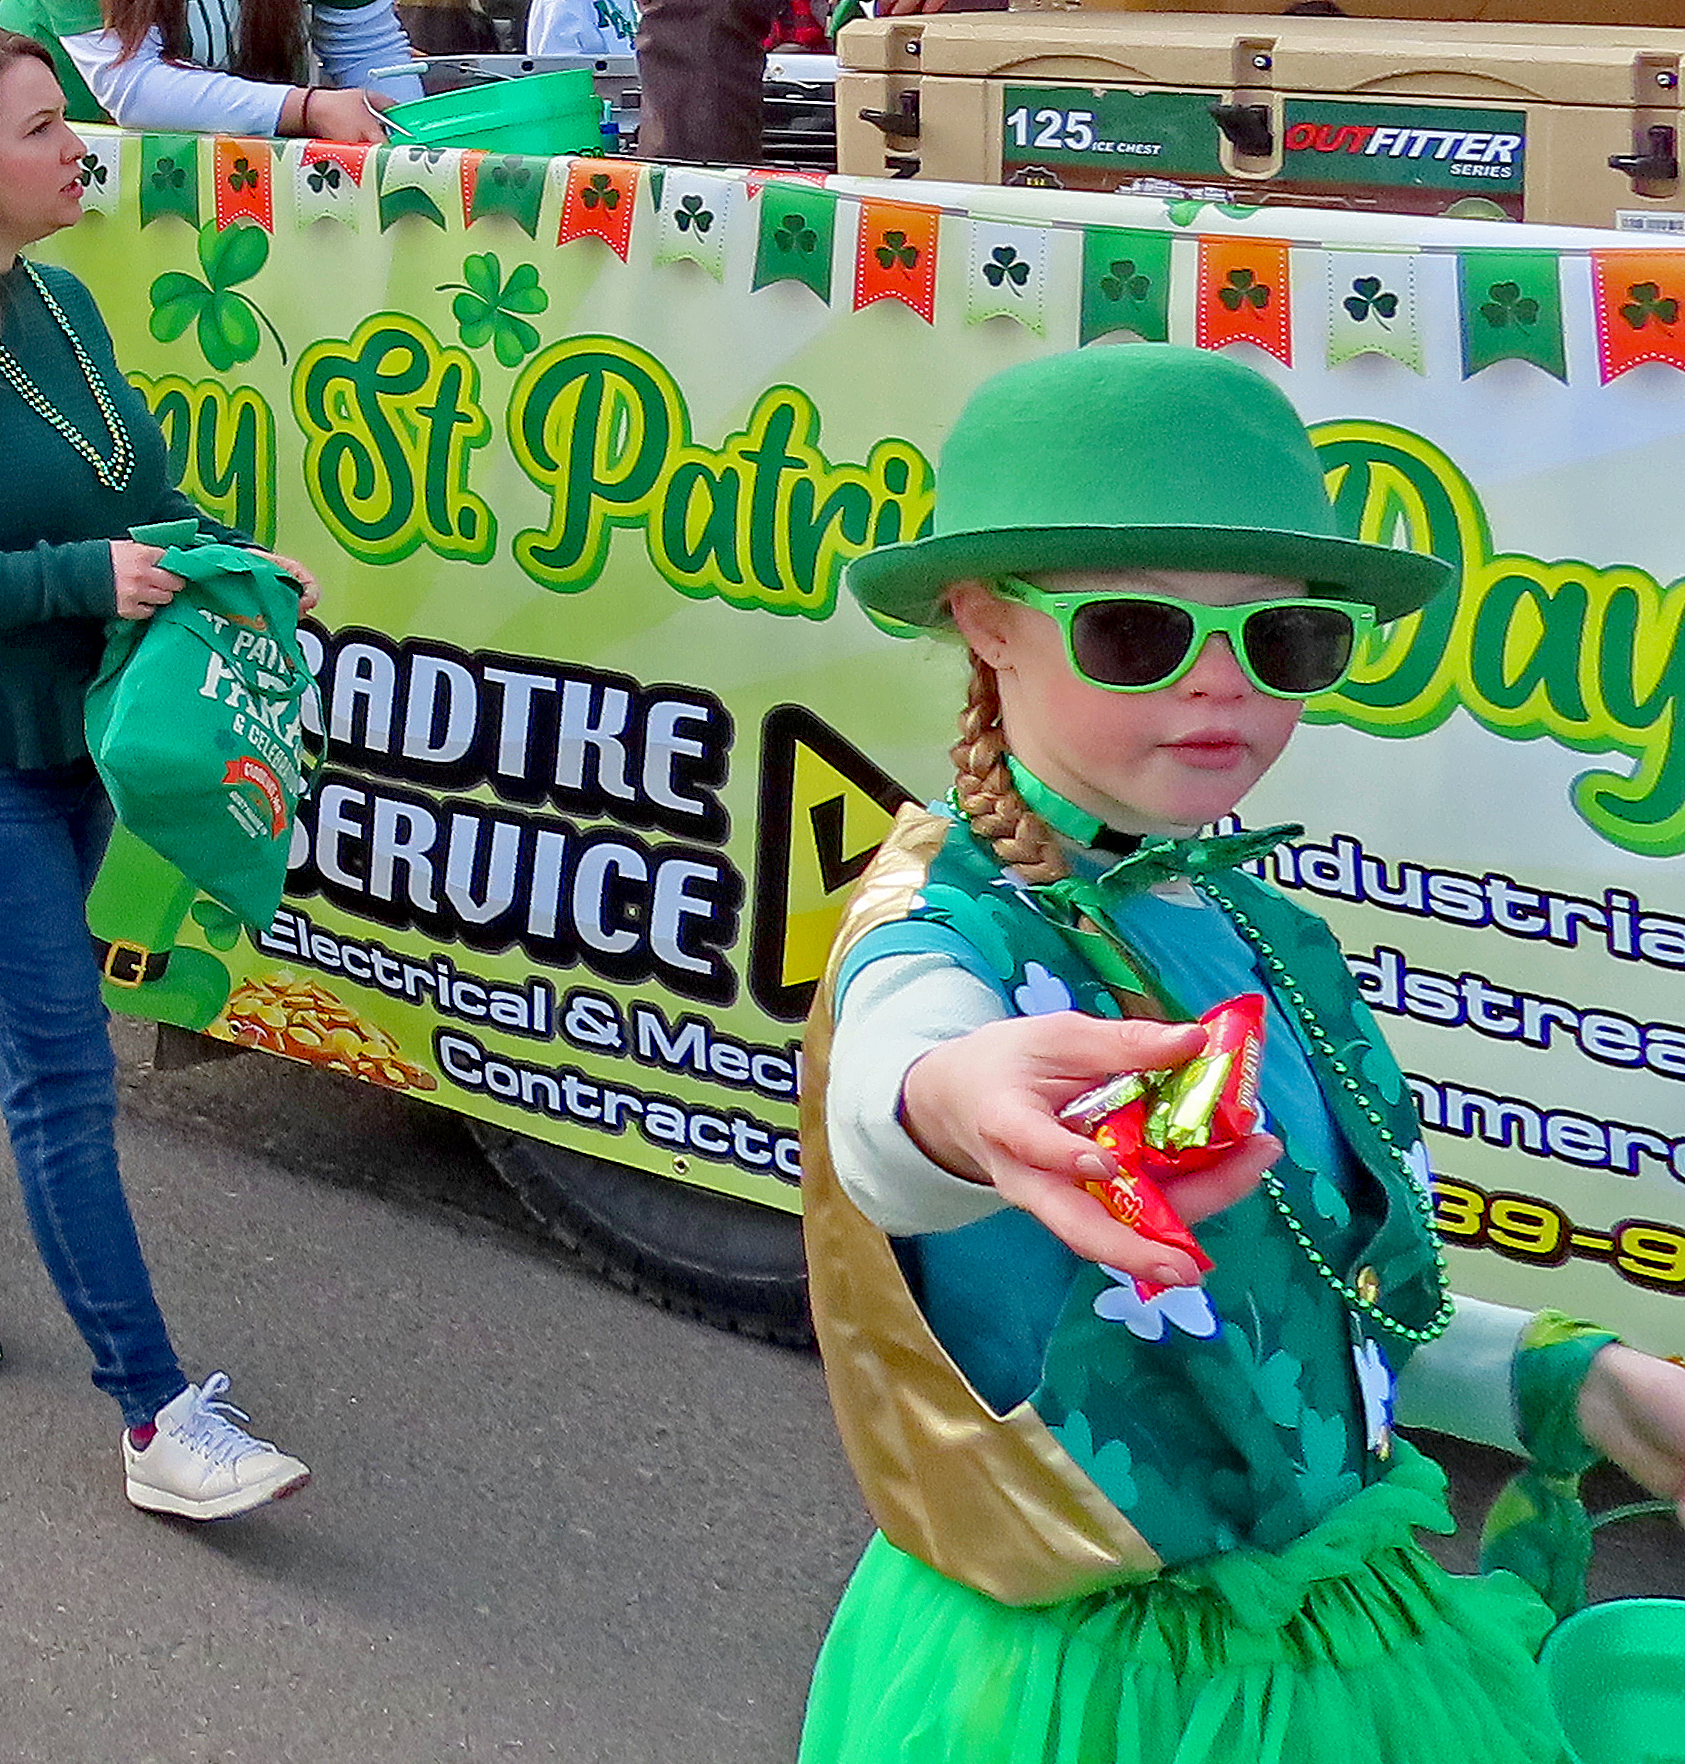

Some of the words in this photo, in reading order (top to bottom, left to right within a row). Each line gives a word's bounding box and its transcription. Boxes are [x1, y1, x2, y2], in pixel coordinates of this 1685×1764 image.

[1007, 108, 1093, 151] 125
[1092, 141, 1115, 153] ICE
[1117, 143, 1162, 155] CHEST
[1285, 123, 1521, 164] OUTFITTER
[1449, 164, 1513, 178] SERIES
[303, 326, 482, 545] St.
[521, 350, 935, 594] Patri
[1217, 815, 1685, 962] ndustria
[259, 908, 548, 1034] Electrical
[564, 996, 623, 1049] &
[438, 1034, 803, 1178] Contracto
